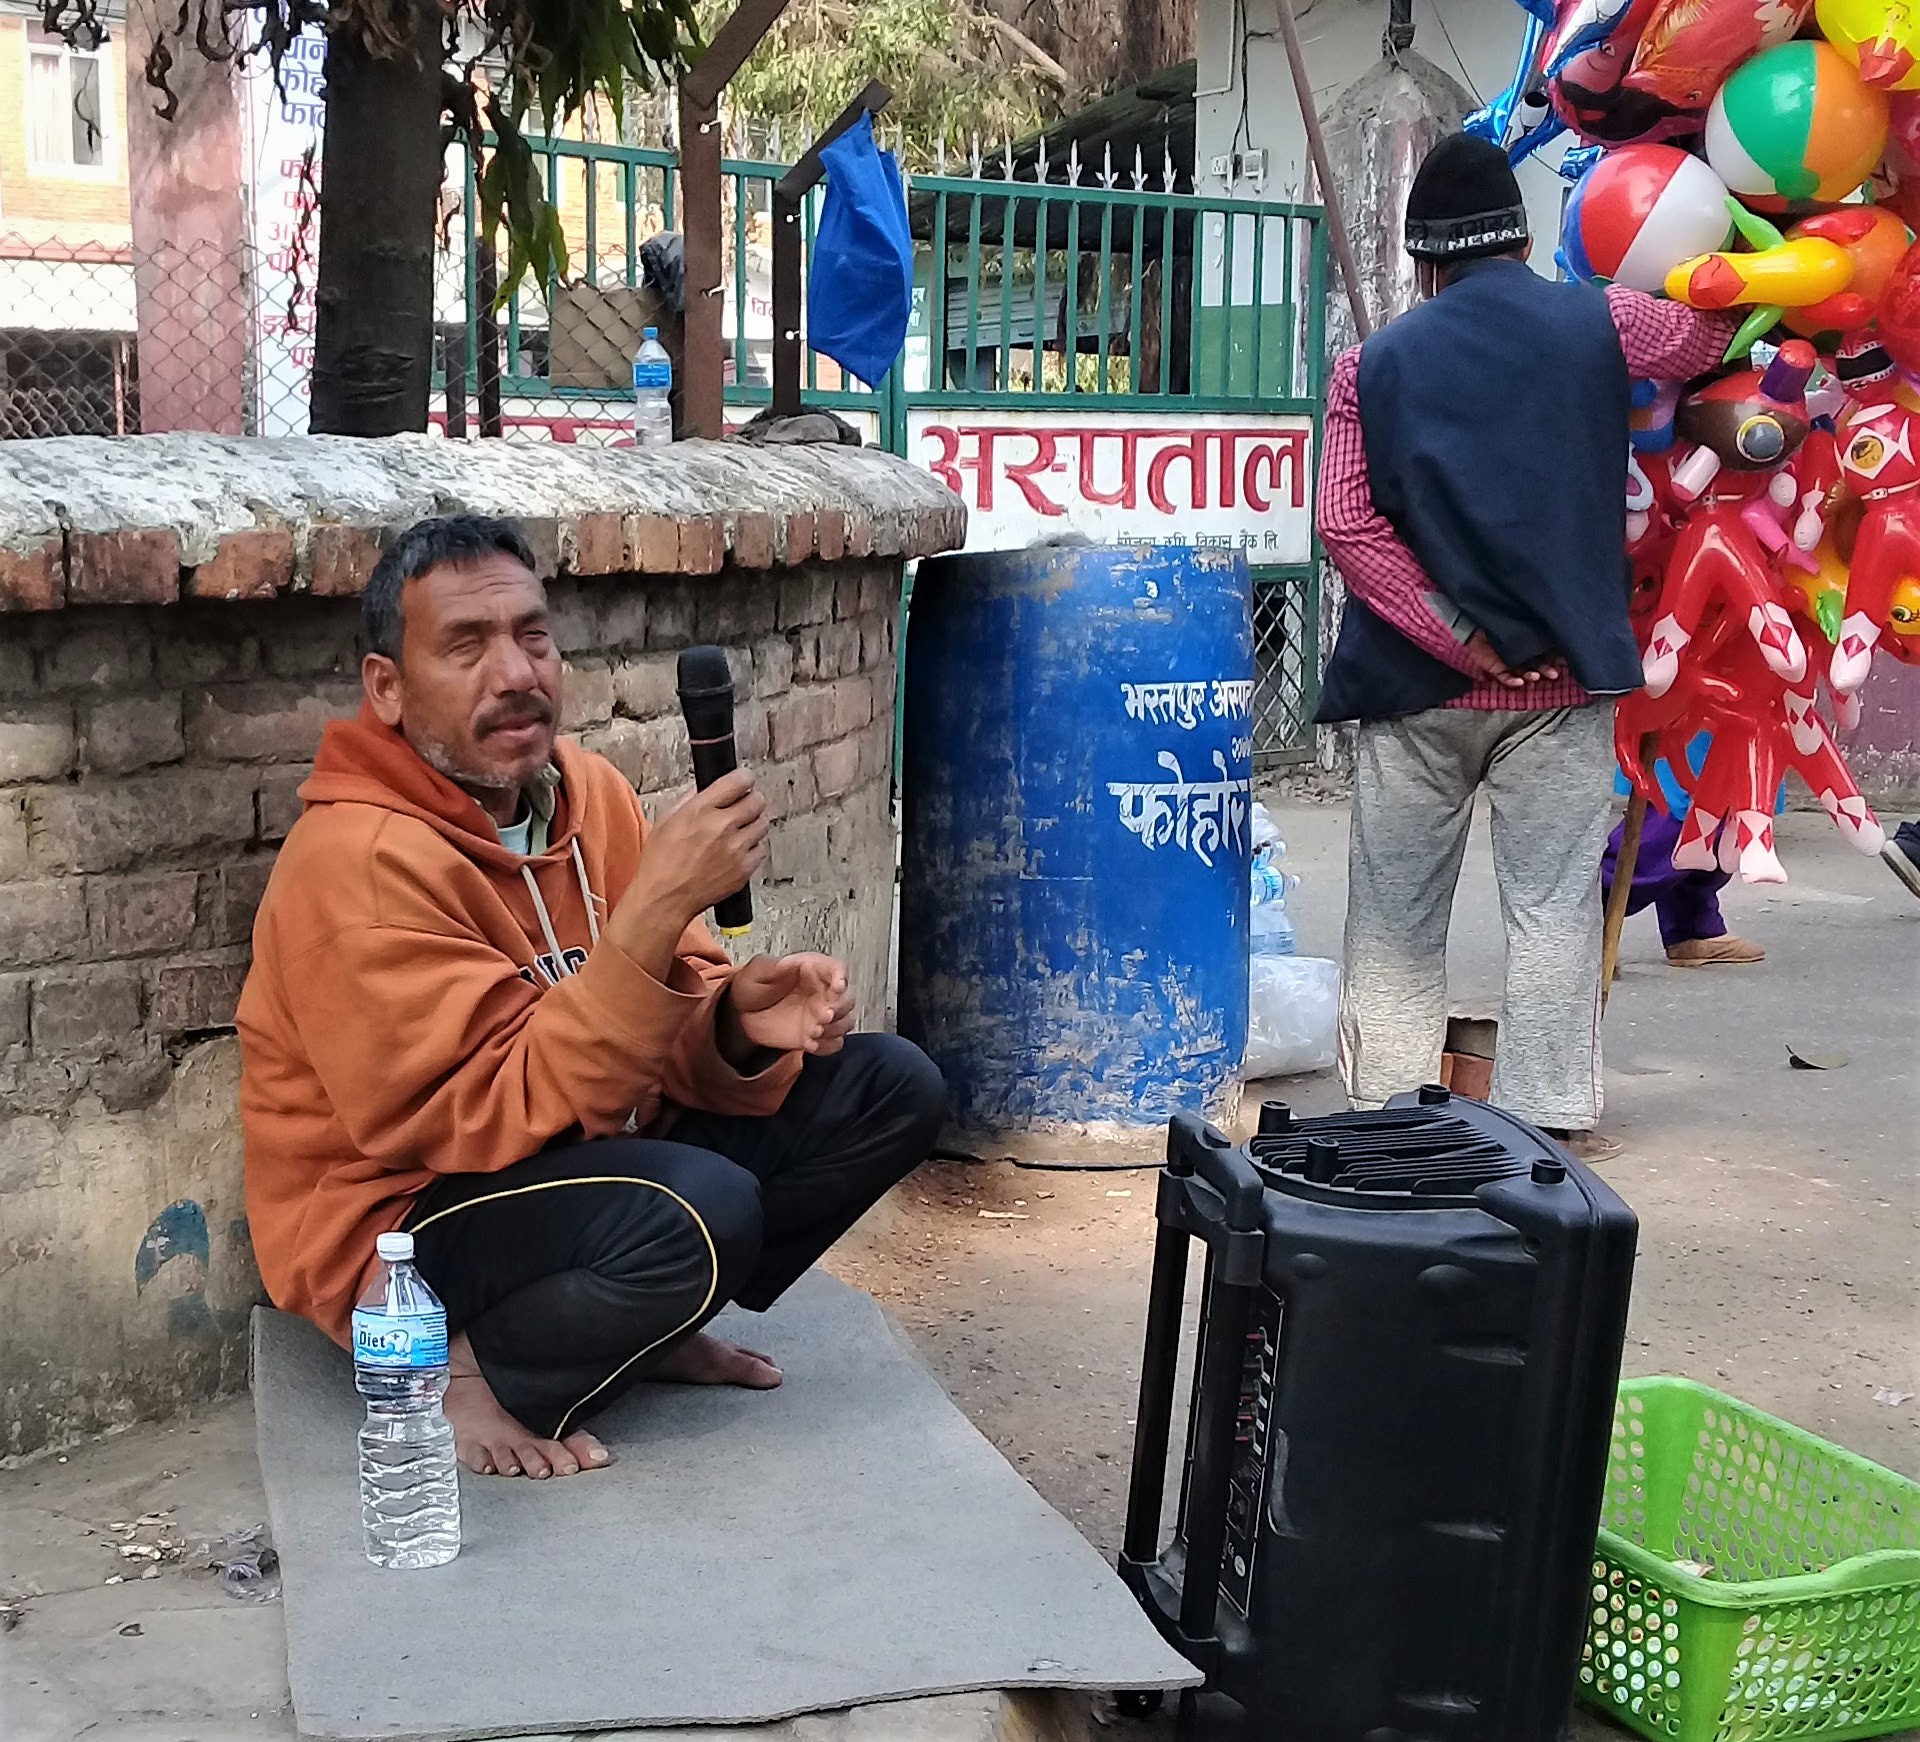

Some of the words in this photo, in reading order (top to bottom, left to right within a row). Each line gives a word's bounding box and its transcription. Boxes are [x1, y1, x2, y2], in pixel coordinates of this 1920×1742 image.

[1447, 226, 1527, 251] NEPAL
[922, 425, 1310, 516] अस्पताल
[359, 1330, 386, 1348] Diet
